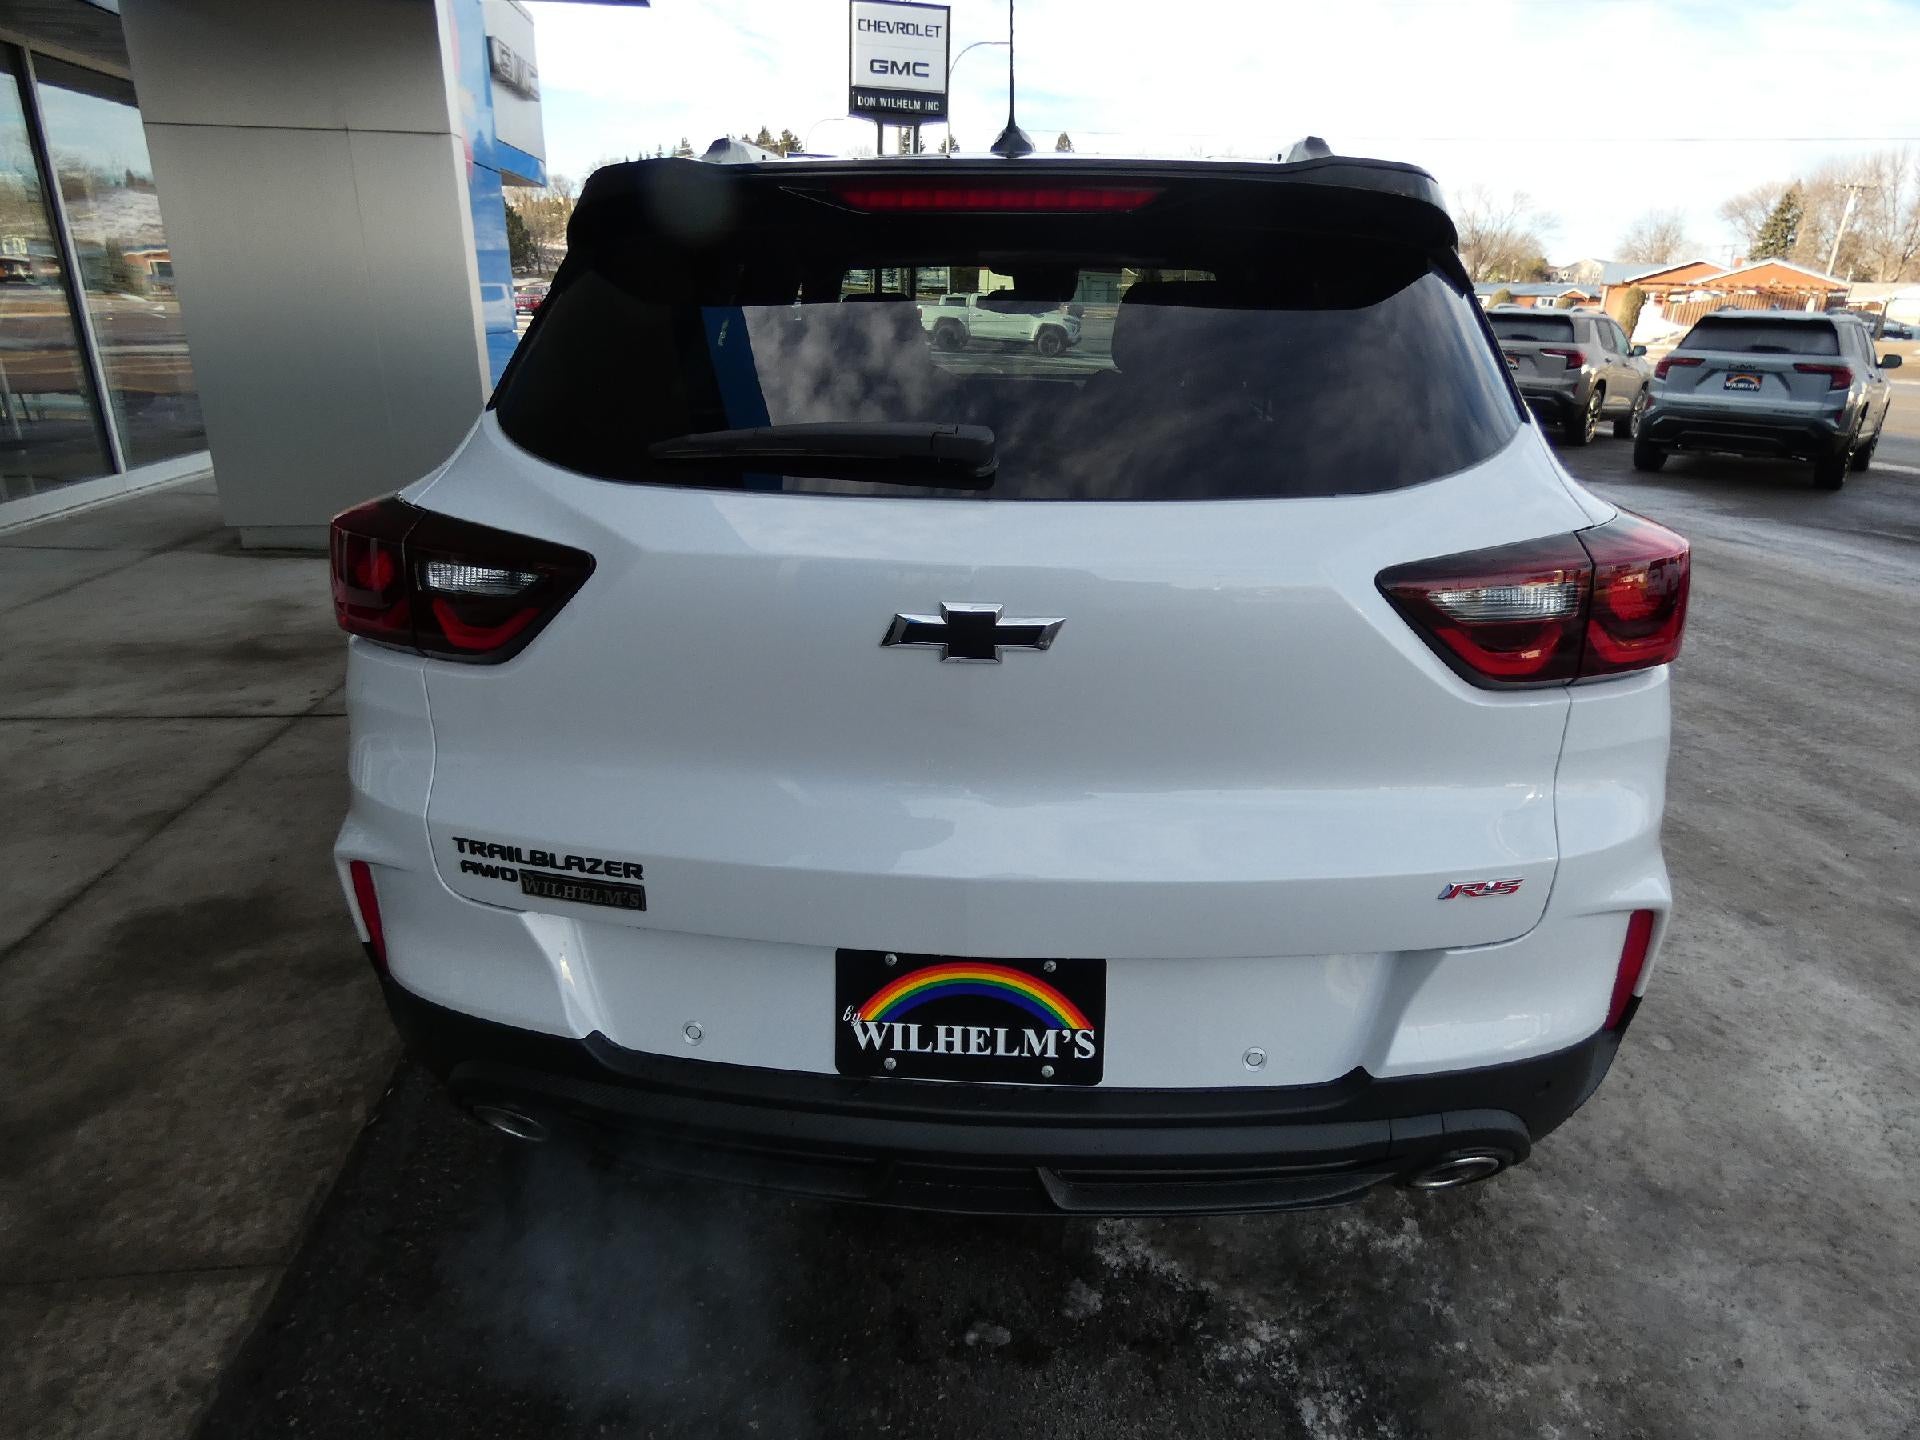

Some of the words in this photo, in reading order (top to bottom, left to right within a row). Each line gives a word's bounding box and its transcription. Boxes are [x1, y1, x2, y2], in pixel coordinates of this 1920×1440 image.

[858, 18, 942, 38] CHEVROLET
[869, 58, 929, 77] GMC
[857, 95, 876, 106] DON
[879, 97, 921, 110] WILHELM
[924, 101, 939, 111] INC
[452, 836, 644, 880] TRAILBLAZER
[460, 859, 519, 883] AWD
[523, 876, 642, 907] WILHELM'S
[1438, 879, 1524, 900] RS
[842, 1004, 863, 1027] by
[852, 1021, 1096, 1058] WILHELM'S
